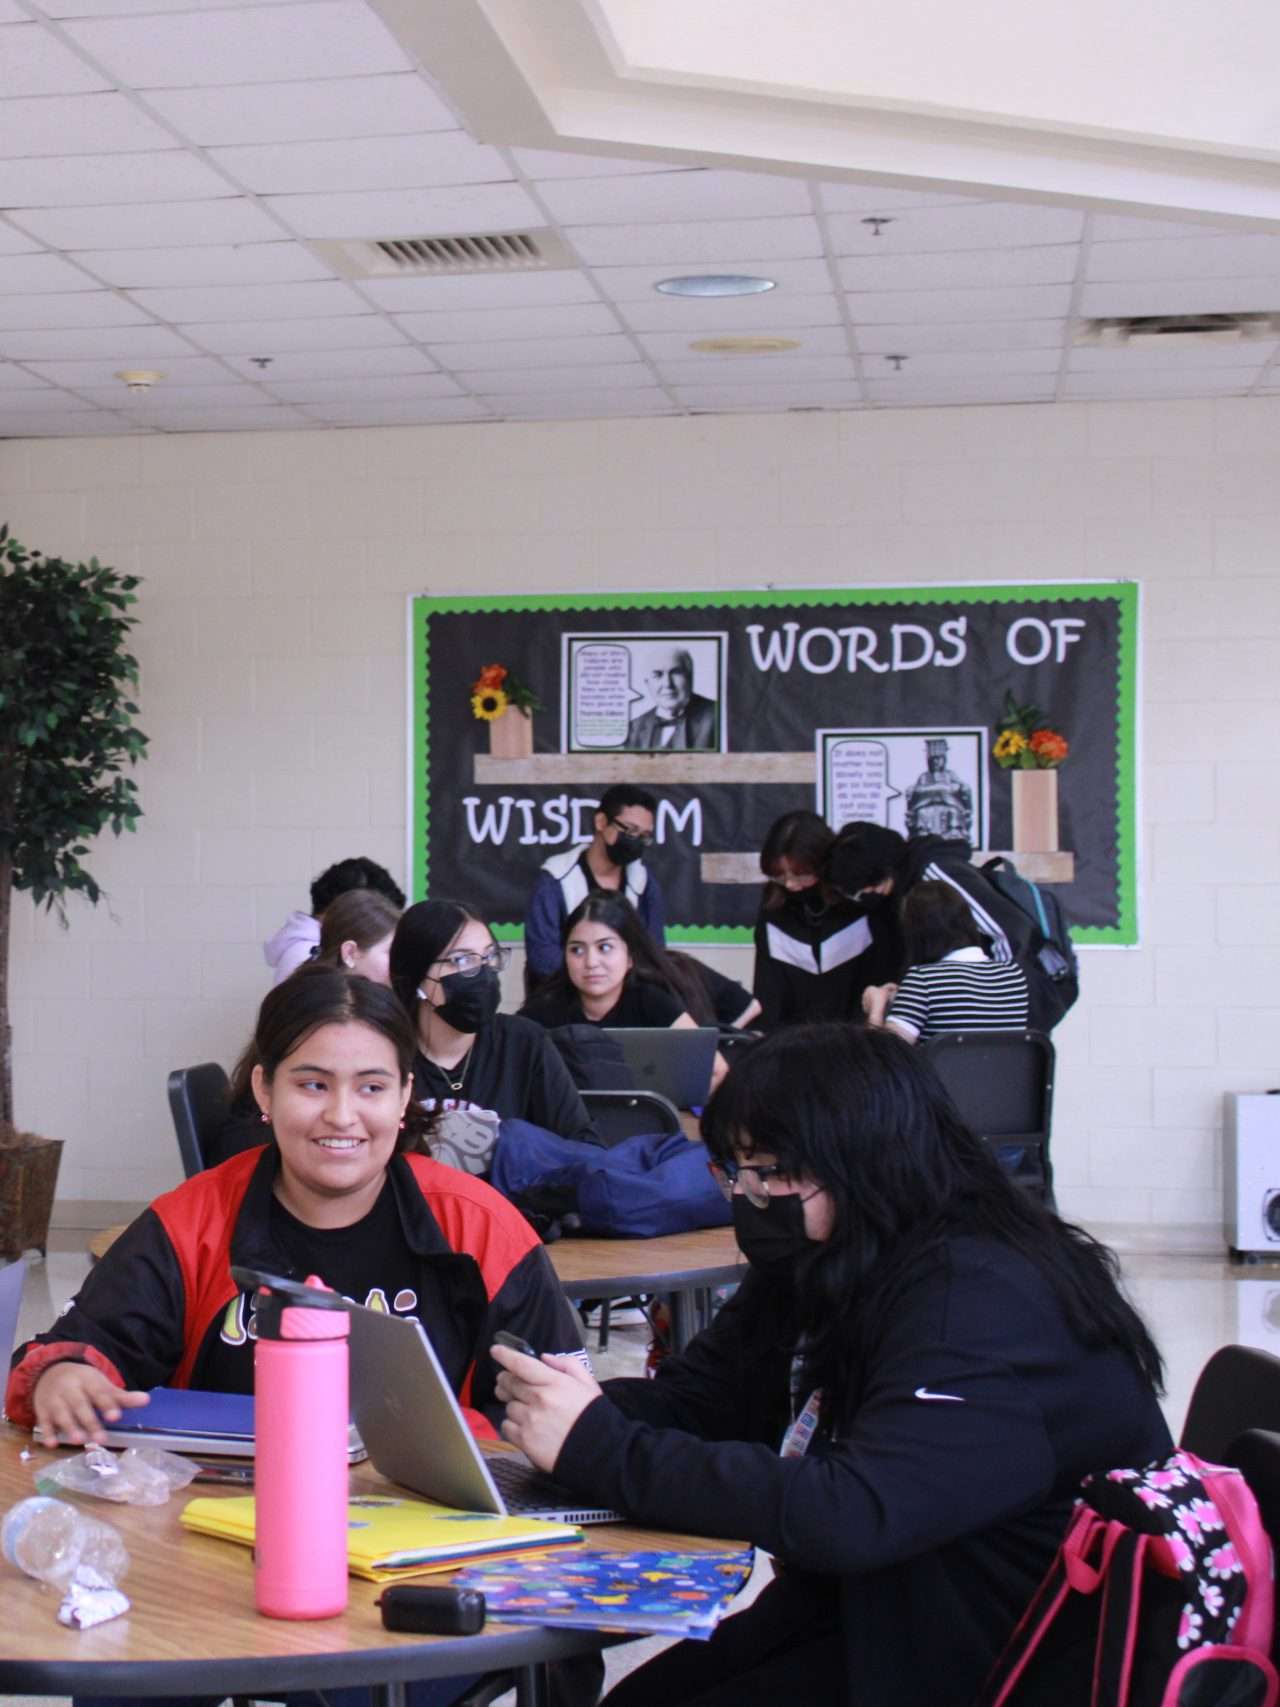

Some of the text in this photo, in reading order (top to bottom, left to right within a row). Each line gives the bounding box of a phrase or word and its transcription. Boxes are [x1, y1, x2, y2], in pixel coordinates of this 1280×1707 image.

[745, 616, 1086, 675] WORDS OF
[462, 794, 703, 846] WISDM
